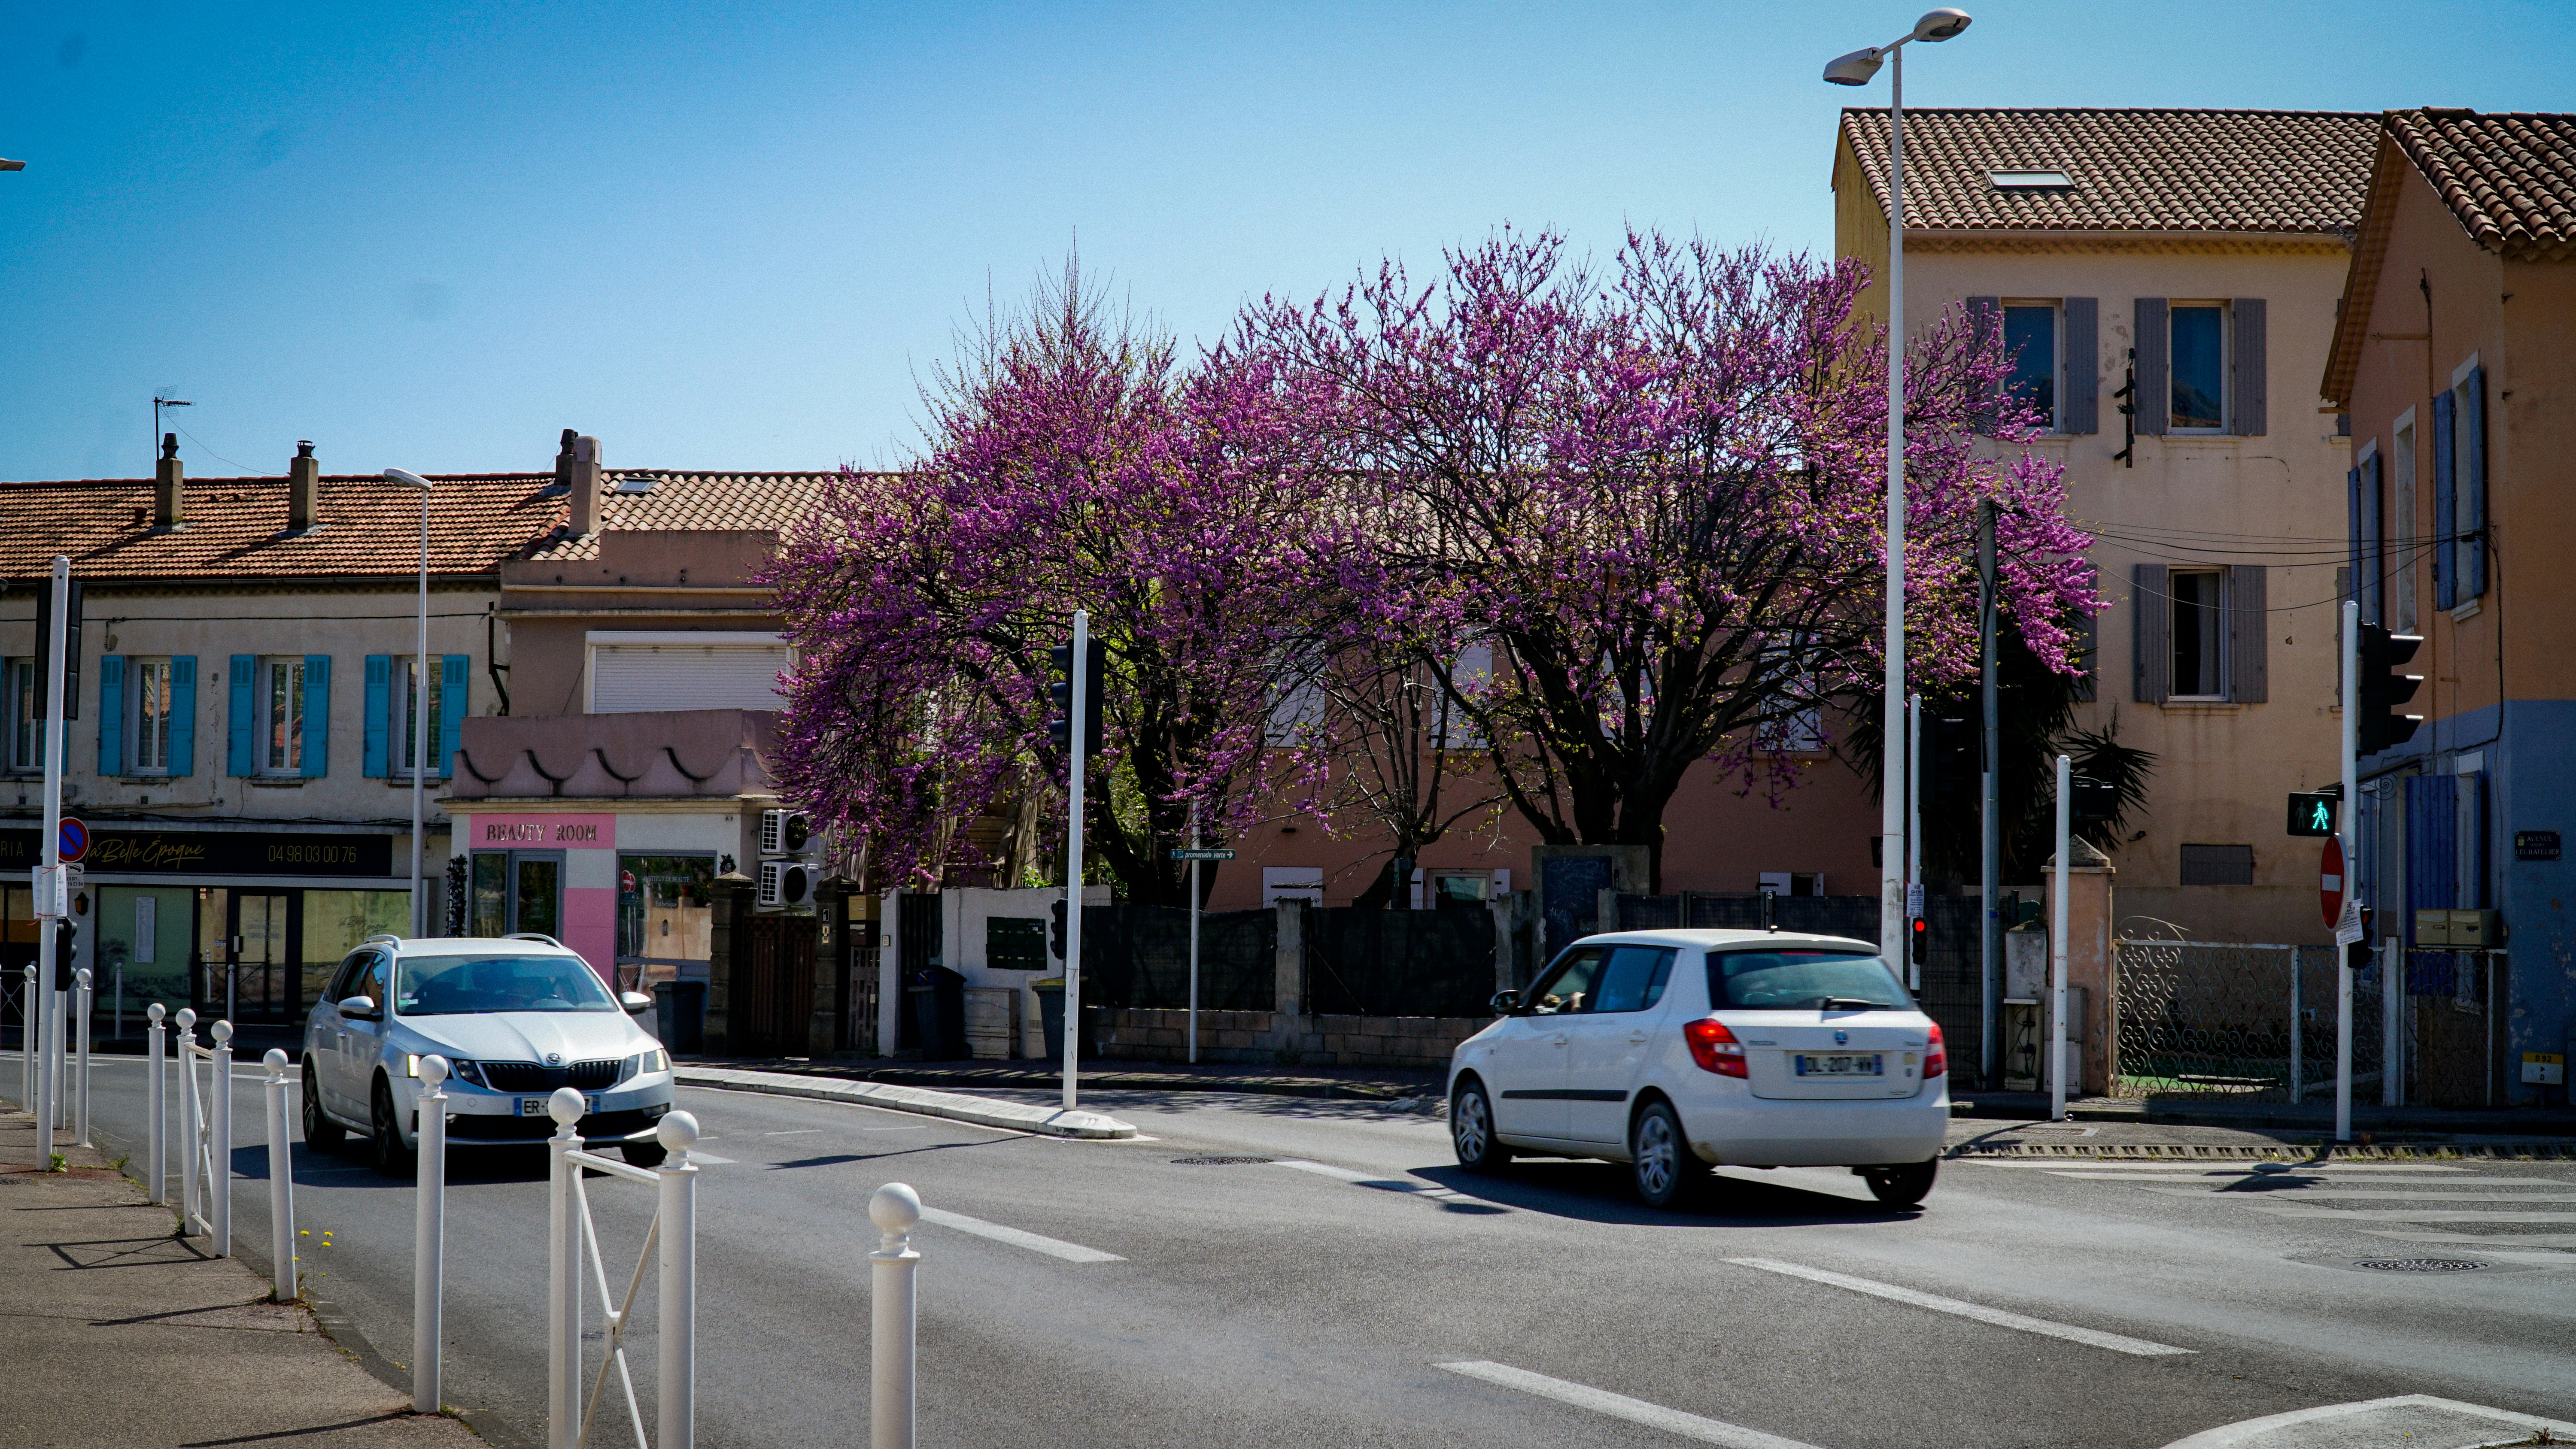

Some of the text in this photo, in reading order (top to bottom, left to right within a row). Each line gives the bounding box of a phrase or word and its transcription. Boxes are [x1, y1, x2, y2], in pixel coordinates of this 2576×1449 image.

[486, 824, 597, 841] BEAUTY ROOM
[98, 839, 142, 863] Belle
[143, 835, 205, 869] Époque
[269, 846, 356, 863] 04 98 03 00 76
[1185, 851, 1212, 859] promenade
[824, 910, 829, 920] 1
